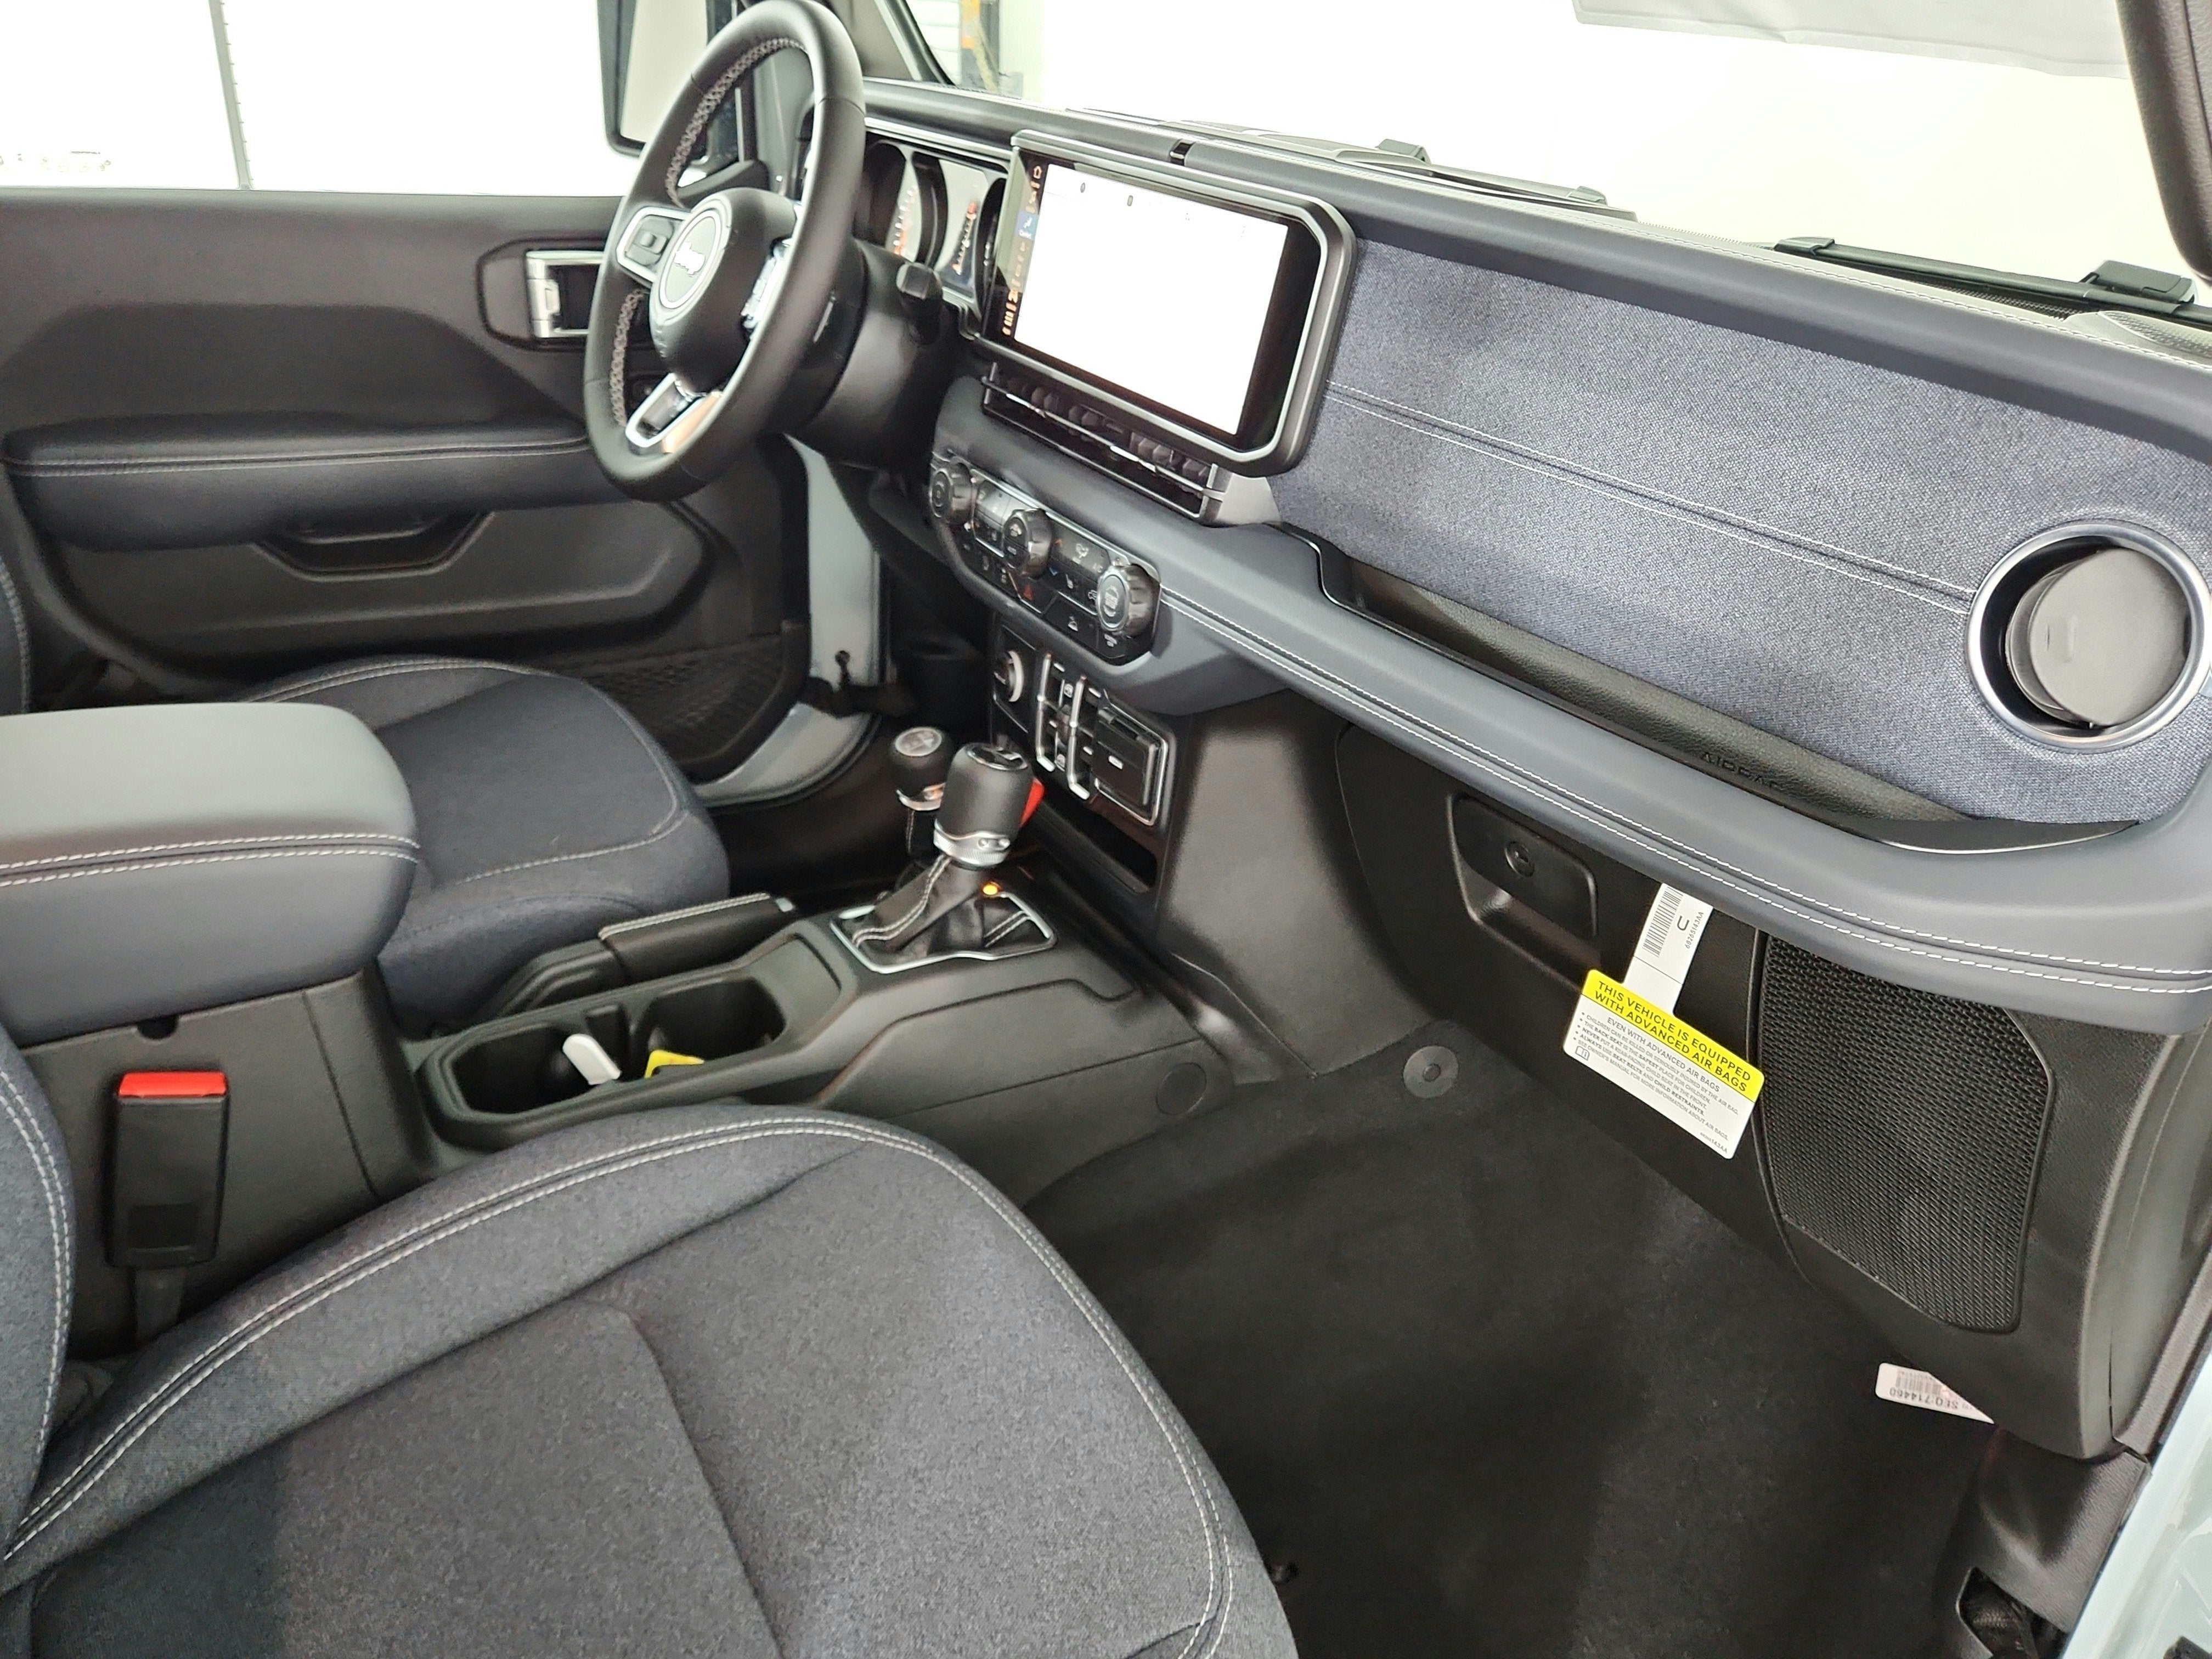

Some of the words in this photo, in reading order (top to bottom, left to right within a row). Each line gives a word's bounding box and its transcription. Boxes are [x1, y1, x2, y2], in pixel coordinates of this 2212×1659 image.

[1677, 916, 1690, 931] U
[1583, 1028, 1600, 1041] NEVER
[1646, 1067, 1661, 1078] CHILD
[1662, 1077, 1673, 1086] SEAT
[1680, 1089, 1690, 1097] THE
[1690, 1096, 1707, 1109] FRONT.
[1587, 1015, 1610, 1031] CHILDREN
[1629, 1041, 1645, 1053] KILLED
[1680, 1074, 1701, 1088] INJURED
[1708, 1092, 1718, 1100] THE
[1595, 991, 1624, 1014] WITH
[1627, 1010, 1690, 1054] ADVANCED
[1693, 1052, 1713, 1069] AIR
[1716, 1066, 1747, 1091] BAGS
[1595, 1028, 1609, 1038] BACK
[1610, 1036, 1623, 1046] SEAT
[1639, 1054, 1660, 1069] SAFEST
[1660, 1068, 1674, 1079] PLACE
[1675, 1078, 1685, 1086] FOR
[1685, 1085, 1712, 1103] CHILDREN.
[1599, 981, 1624, 1002] THIS
[1627, 998, 1675, 1032] VEHICLE
[1678, 1030, 1689, 1041] IS
[1692, 1039, 1751, 1081] EQUIPPED
[1608, 1018, 1626, 1032] EVEN
[1627, 1029, 1646, 1044] WITH
[1647, 1042, 1686, 1069] ADVANCED
[1687, 1067, 1699, 1078] AIR
[1701, 1076, 1720, 1092] BAGS
[1581, 1033, 1602, 1049] ALWAYS
[1613, 1054, 1626, 1064] SEAT
[1627, 1063, 1643, 1074] BELTS
[1644, 1073, 1654, 1081] AND
[1655, 1080, 1671, 1092] CHILD
[1672, 1092, 1706, 1115] RESTRAINTS.
[1610, 1059, 1630, 1074] MANUAL
[1641, 1079, 1655, 1090] MORE
[1656, 1088, 1688, 1111] INFORMATION
[1689, 1111, 1705, 1123] ABOUT
